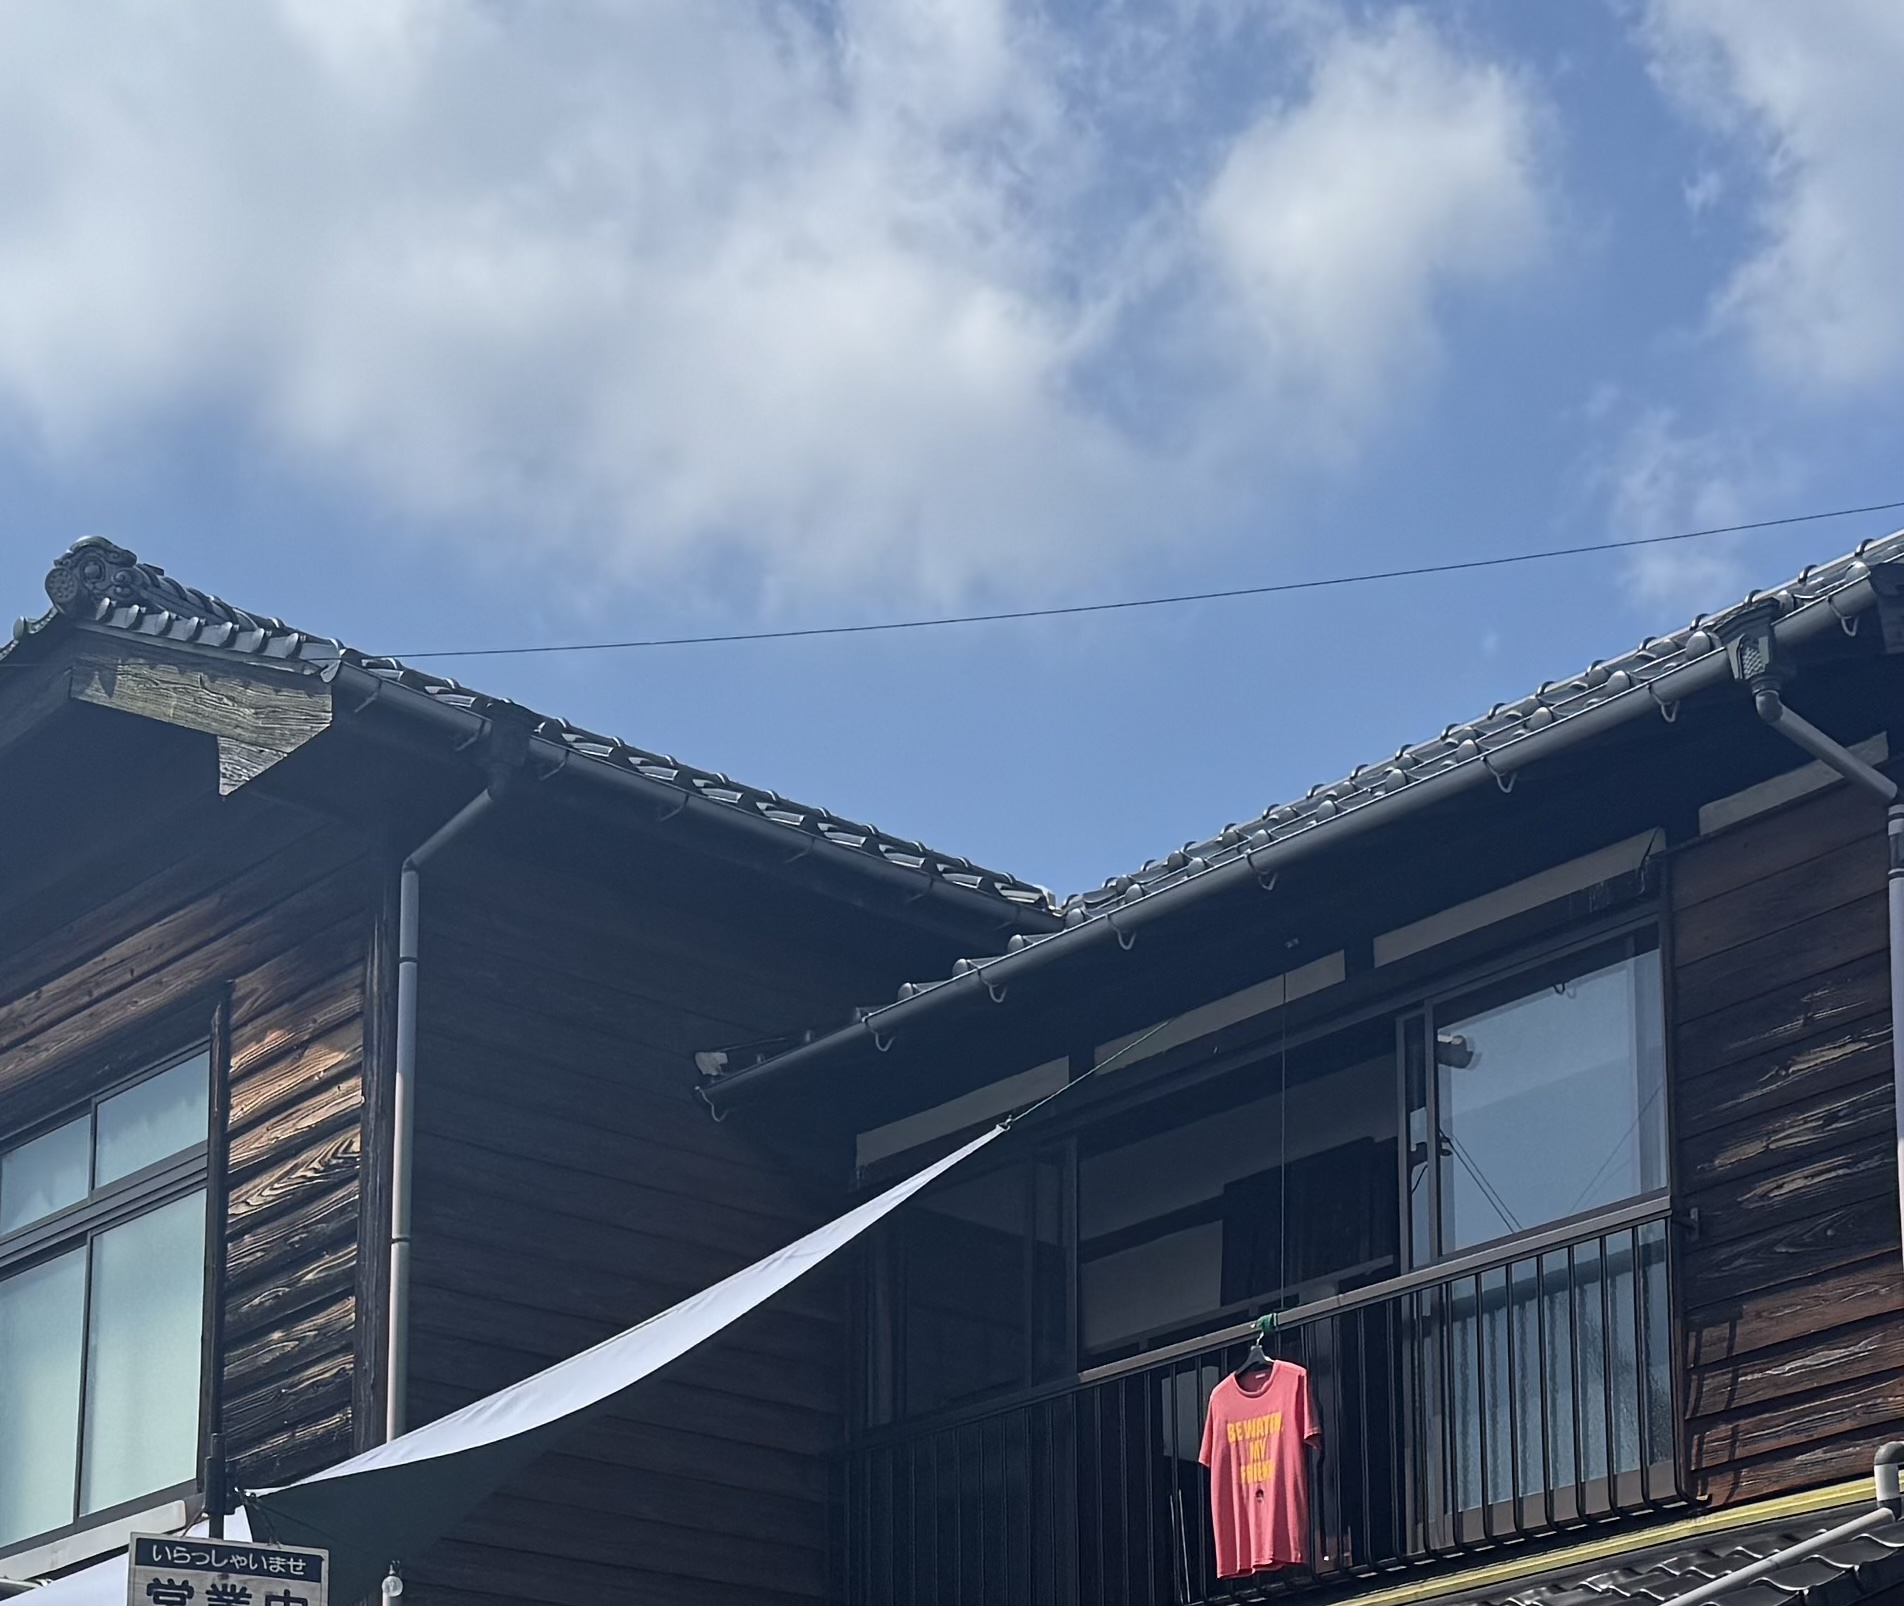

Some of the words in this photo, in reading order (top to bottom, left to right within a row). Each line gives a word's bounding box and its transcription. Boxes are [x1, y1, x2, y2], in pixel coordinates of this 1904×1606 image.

[1227, 1421, 1244, 1444] BE
[1250, 1438, 1267, 1463] MY
[152, 1544, 307, 1576] いらっしゃいませ
